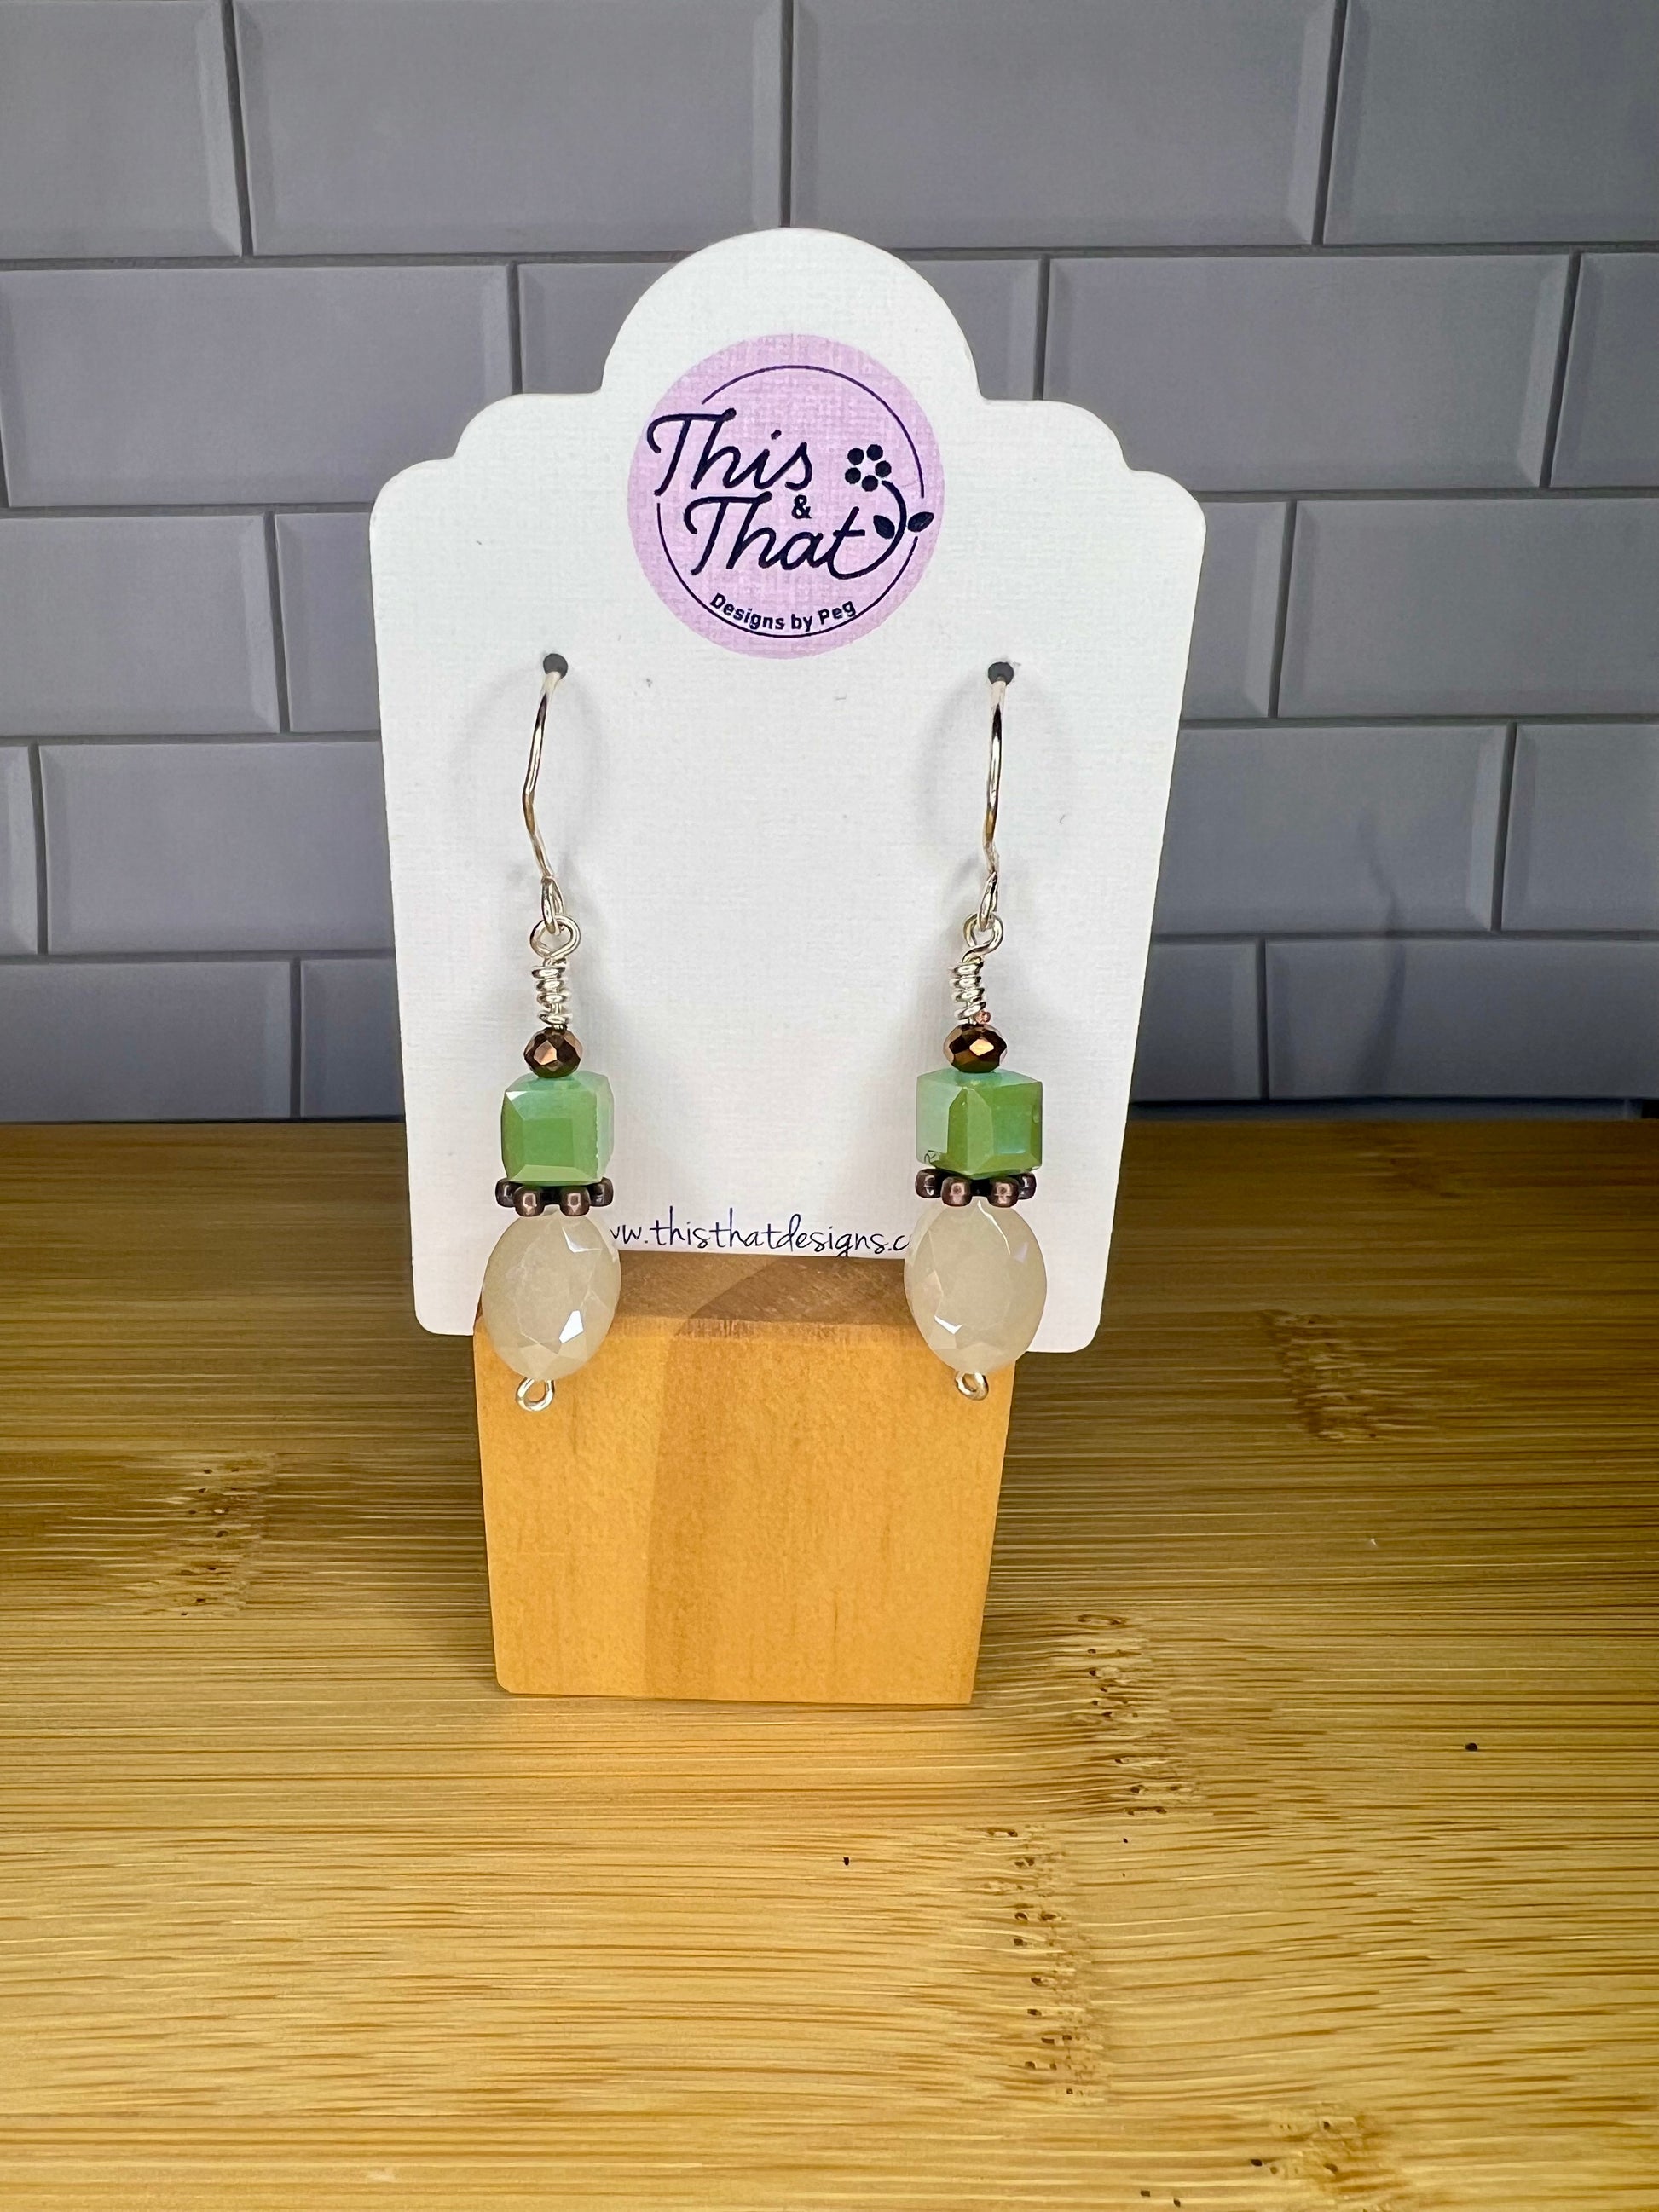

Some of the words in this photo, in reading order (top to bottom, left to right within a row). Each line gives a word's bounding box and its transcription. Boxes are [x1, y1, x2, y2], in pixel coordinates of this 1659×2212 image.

[646, 407, 812, 496] This
[791, 494, 812, 519] &
[683, 491, 871, 580] That
[709, 592, 785, 630] Designs
[790, 613, 812, 632] by
[818, 600, 857, 625] Peg
[609, 1204, 912, 1258] w.thisthatdesigns.c
